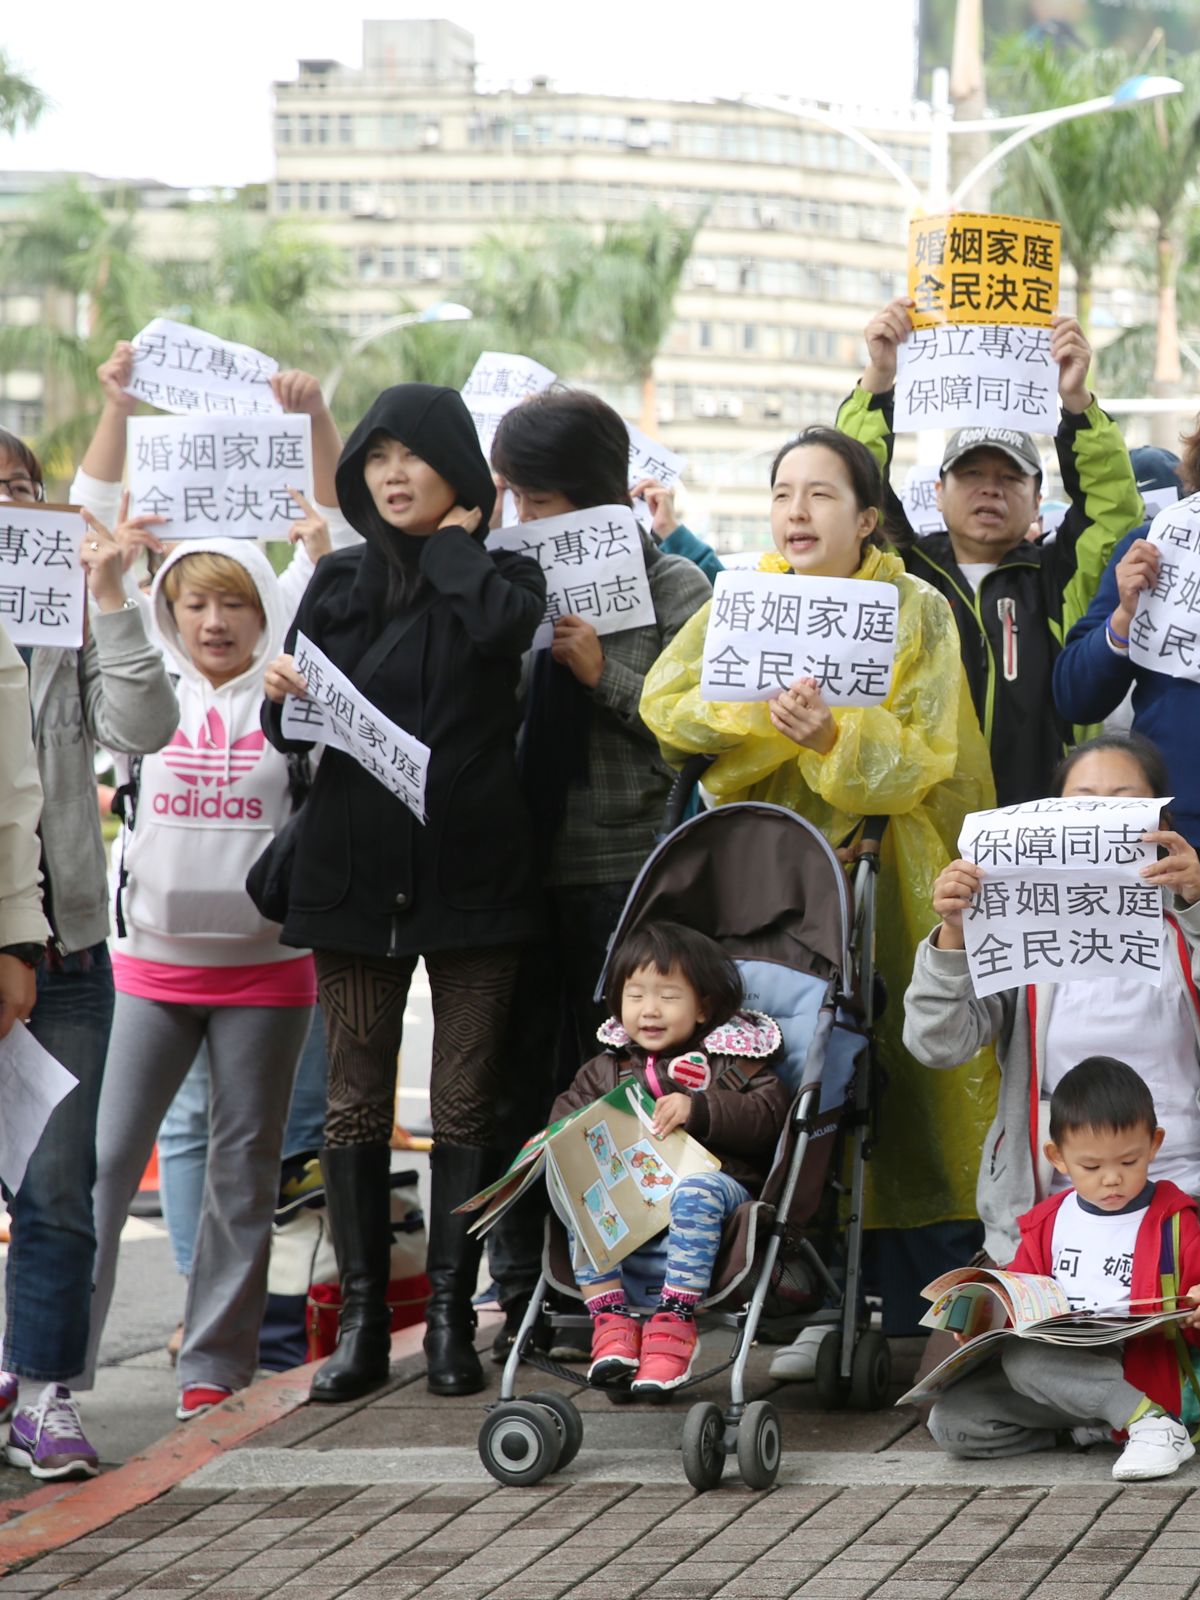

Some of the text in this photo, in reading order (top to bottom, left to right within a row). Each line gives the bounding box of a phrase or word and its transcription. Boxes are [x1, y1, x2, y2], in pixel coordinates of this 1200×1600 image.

[914, 227, 1054, 272] 婚姻家庭
[913, 273, 1053, 315] 全民決定
[133, 332, 270, 385] 另立專法
[907, 325, 1051, 368] 另立專法
[905, 374, 1049, 415] 保障同志
[135, 431, 305, 472] 婚姻家庭
[137, 484, 308, 523] 全民決定
[497, 521, 631, 572] 立專法
[713, 589, 896, 643] 婚姻家庭
[708, 644, 890, 698] 全民決定
[297, 649, 422, 789] 婚姻家庭
[153, 789, 263, 820] adidas
[970, 823, 1148, 866] 保障同志
[968, 880, 1162, 921] 婚姻家庭
[970, 928, 1162, 979] 全民決定
